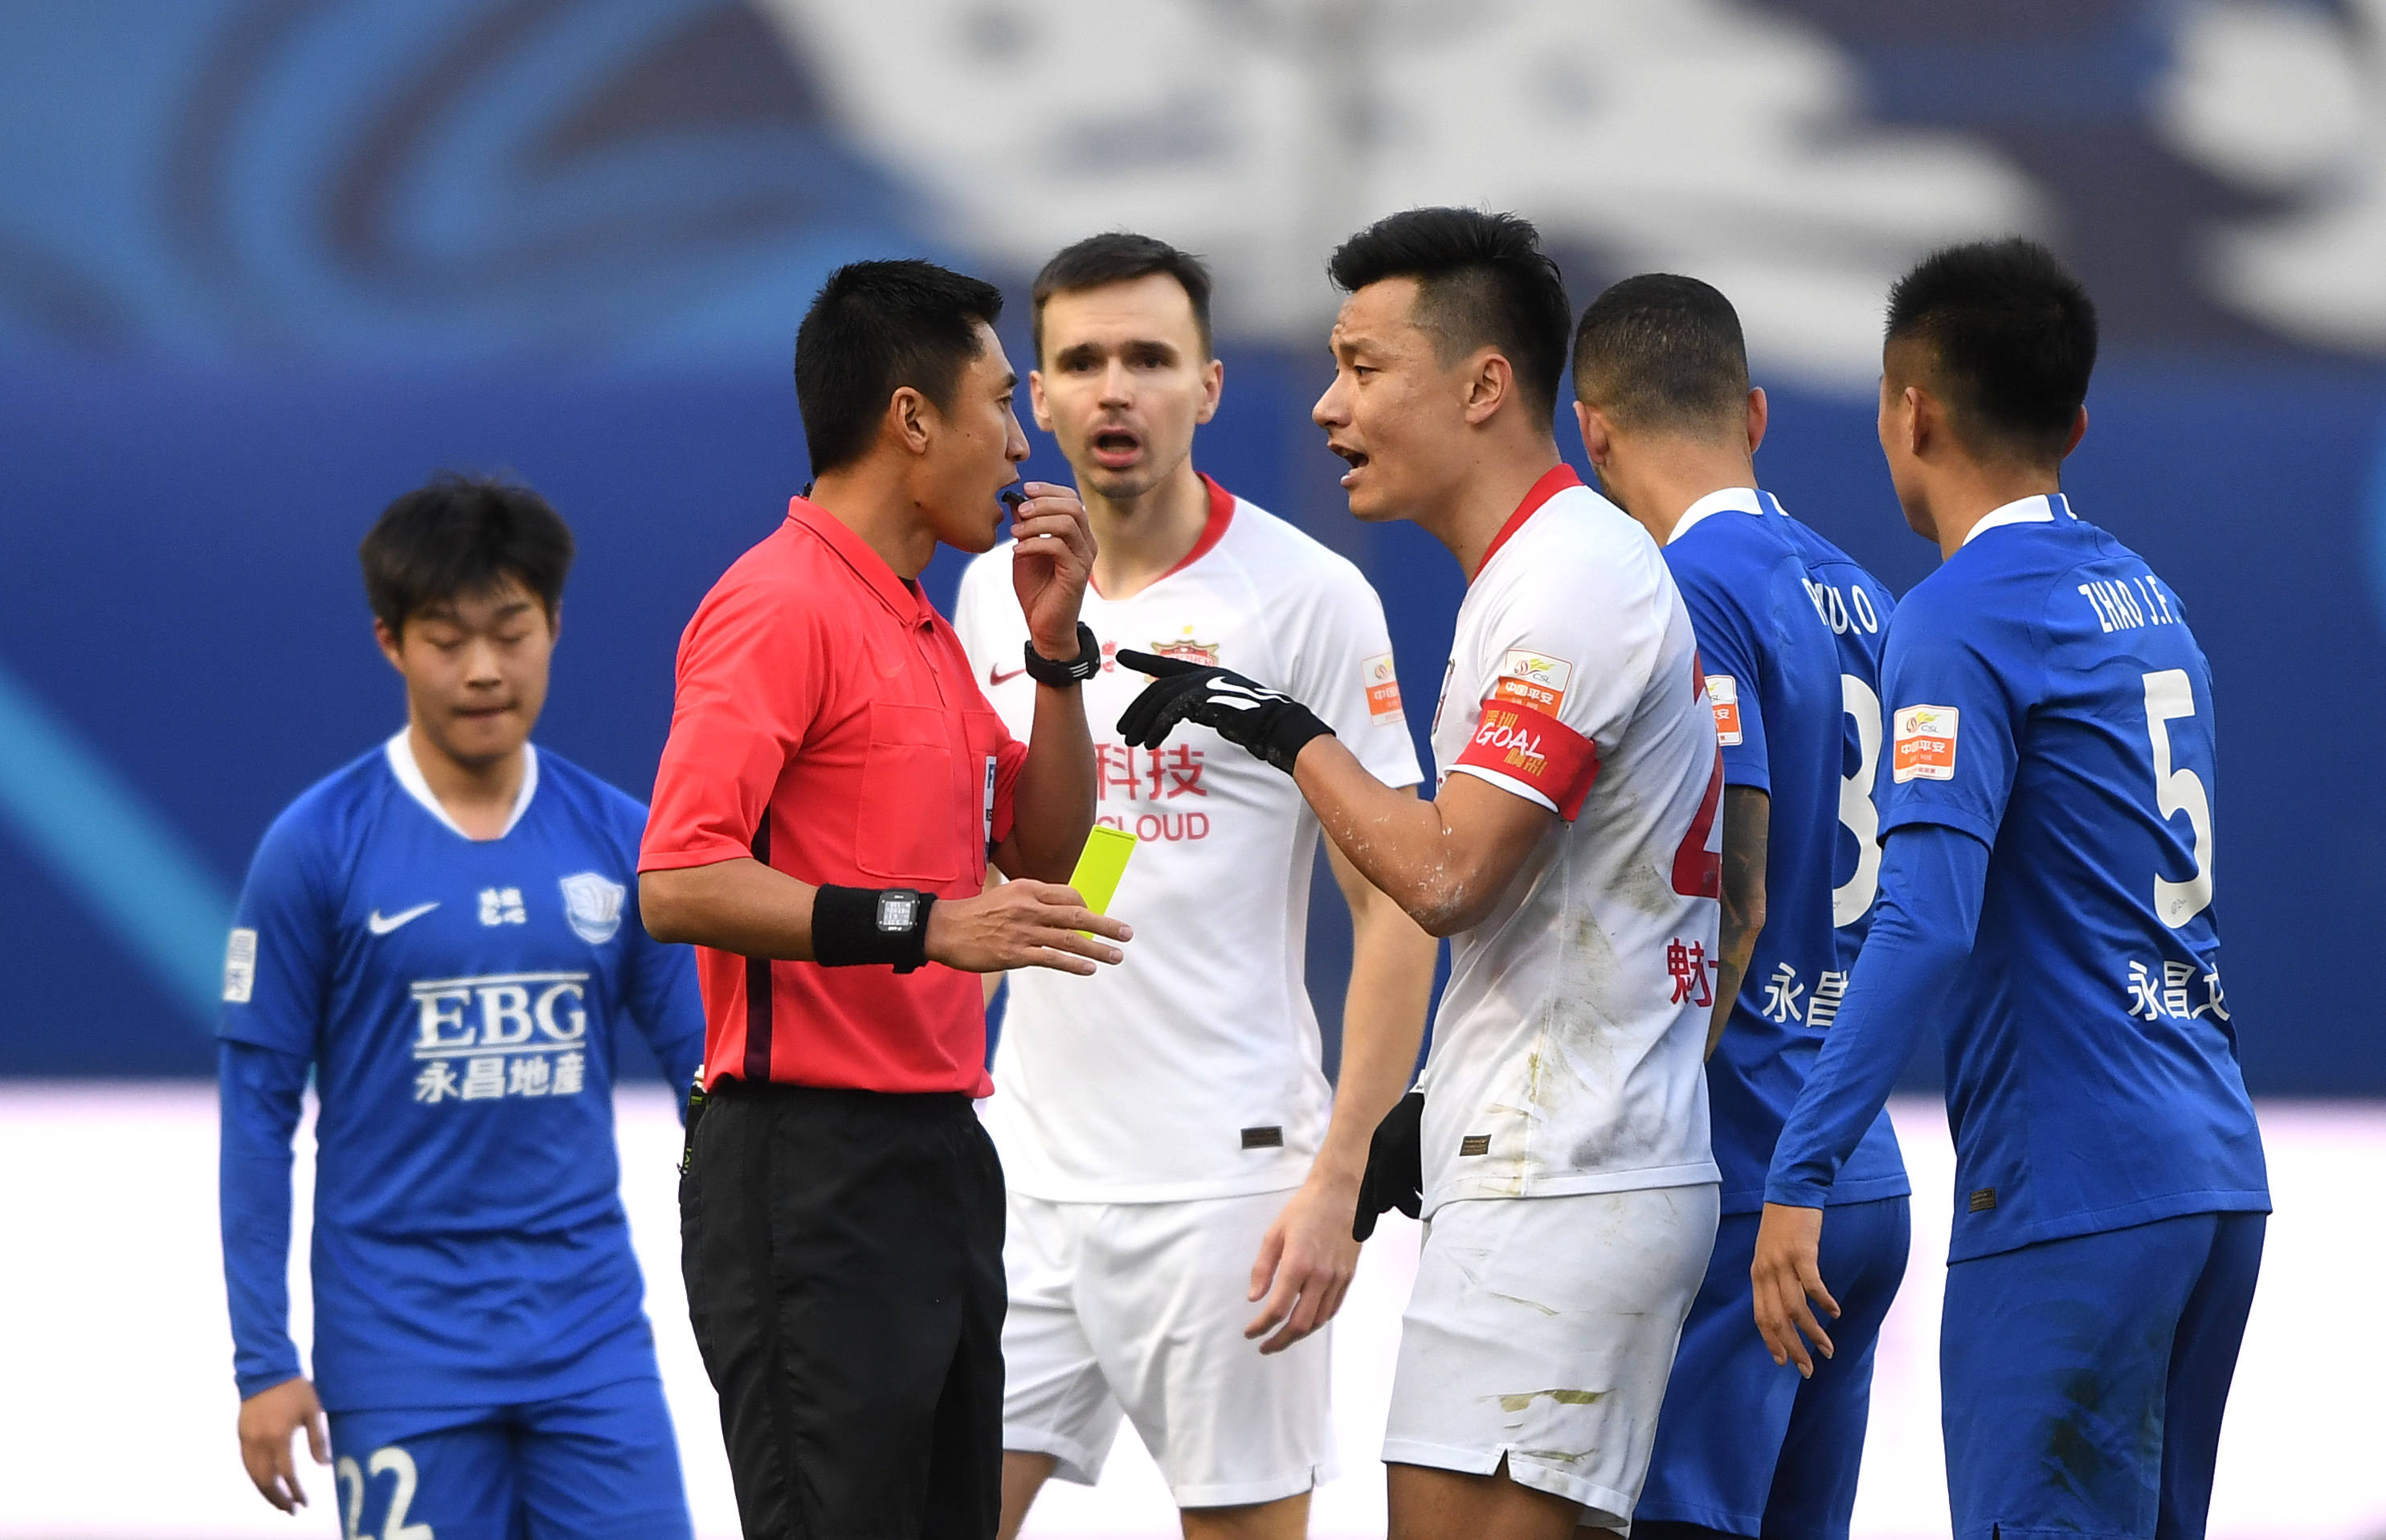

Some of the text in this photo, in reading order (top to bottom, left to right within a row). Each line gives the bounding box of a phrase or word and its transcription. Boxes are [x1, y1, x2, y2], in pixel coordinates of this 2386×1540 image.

[2078, 583, 2144, 633] ZHAO
[1476, 721, 1546, 760] GOAL
[2143, 669, 2212, 929] 5
[411, 983, 587, 1048] EBG
[337, 1446, 435, 1540] 22
